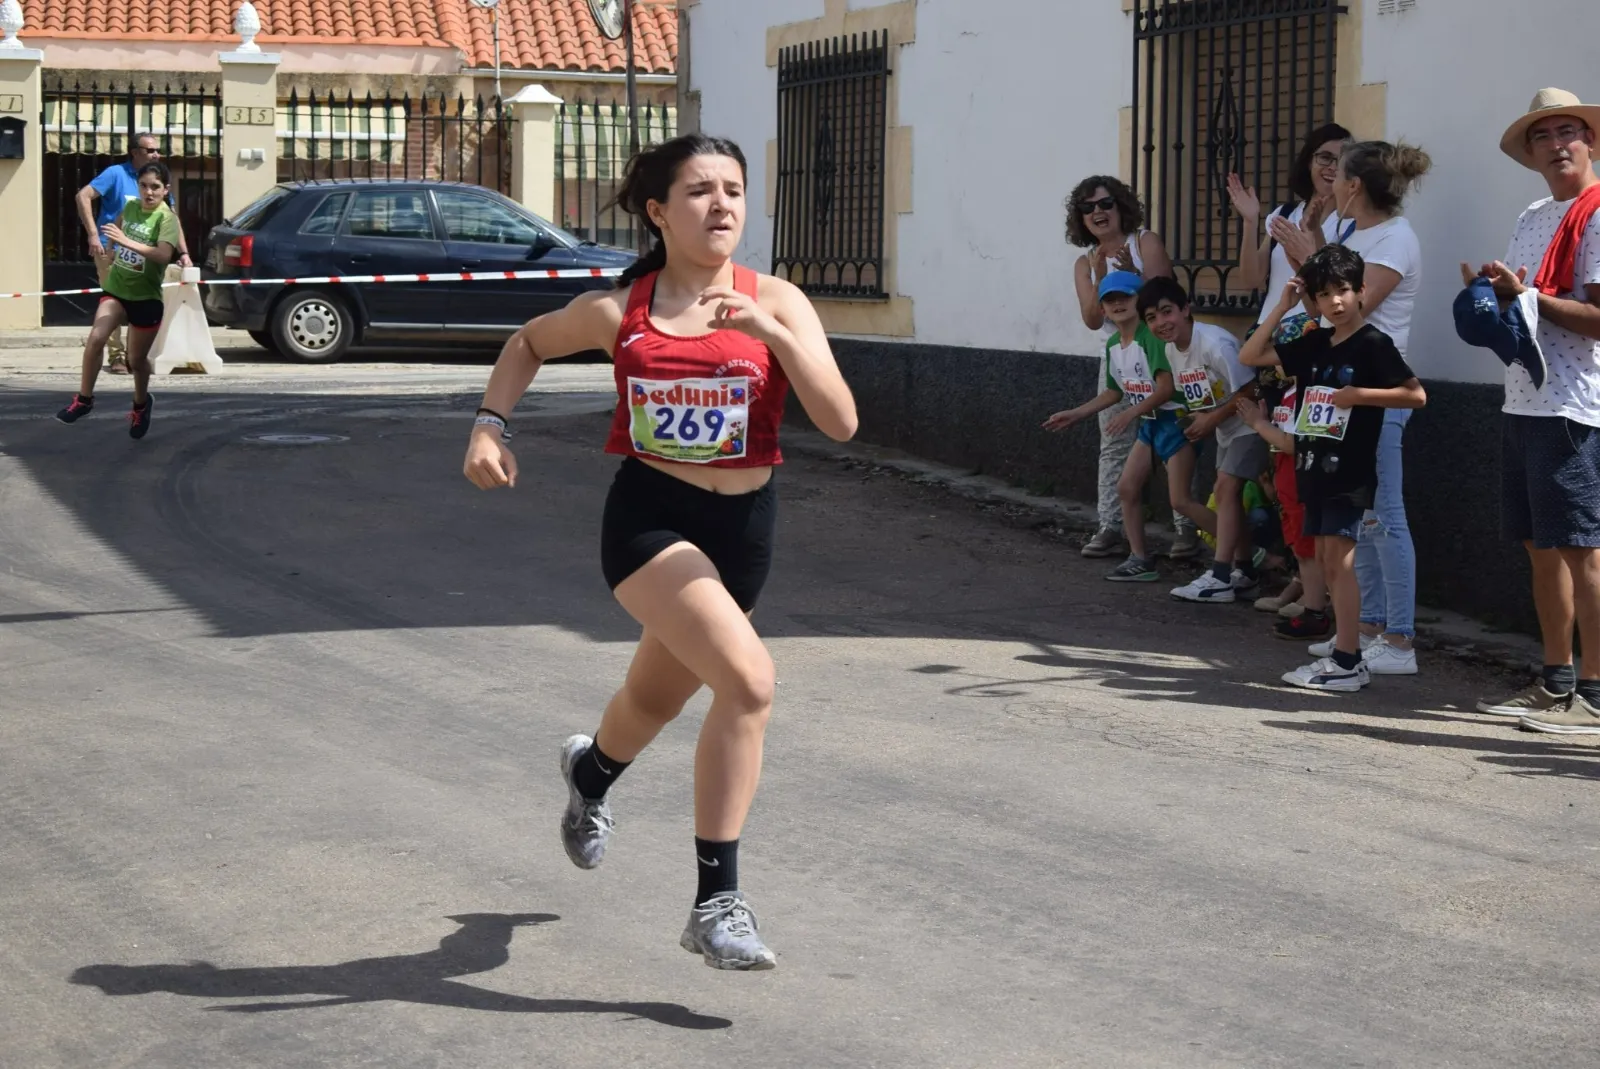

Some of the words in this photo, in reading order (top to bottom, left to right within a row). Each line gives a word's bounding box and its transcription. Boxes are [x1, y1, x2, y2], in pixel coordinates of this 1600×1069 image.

[232, 109, 267, 123] 35
[118, 247, 138, 264] 265
[653, 406, 726, 442] 269
